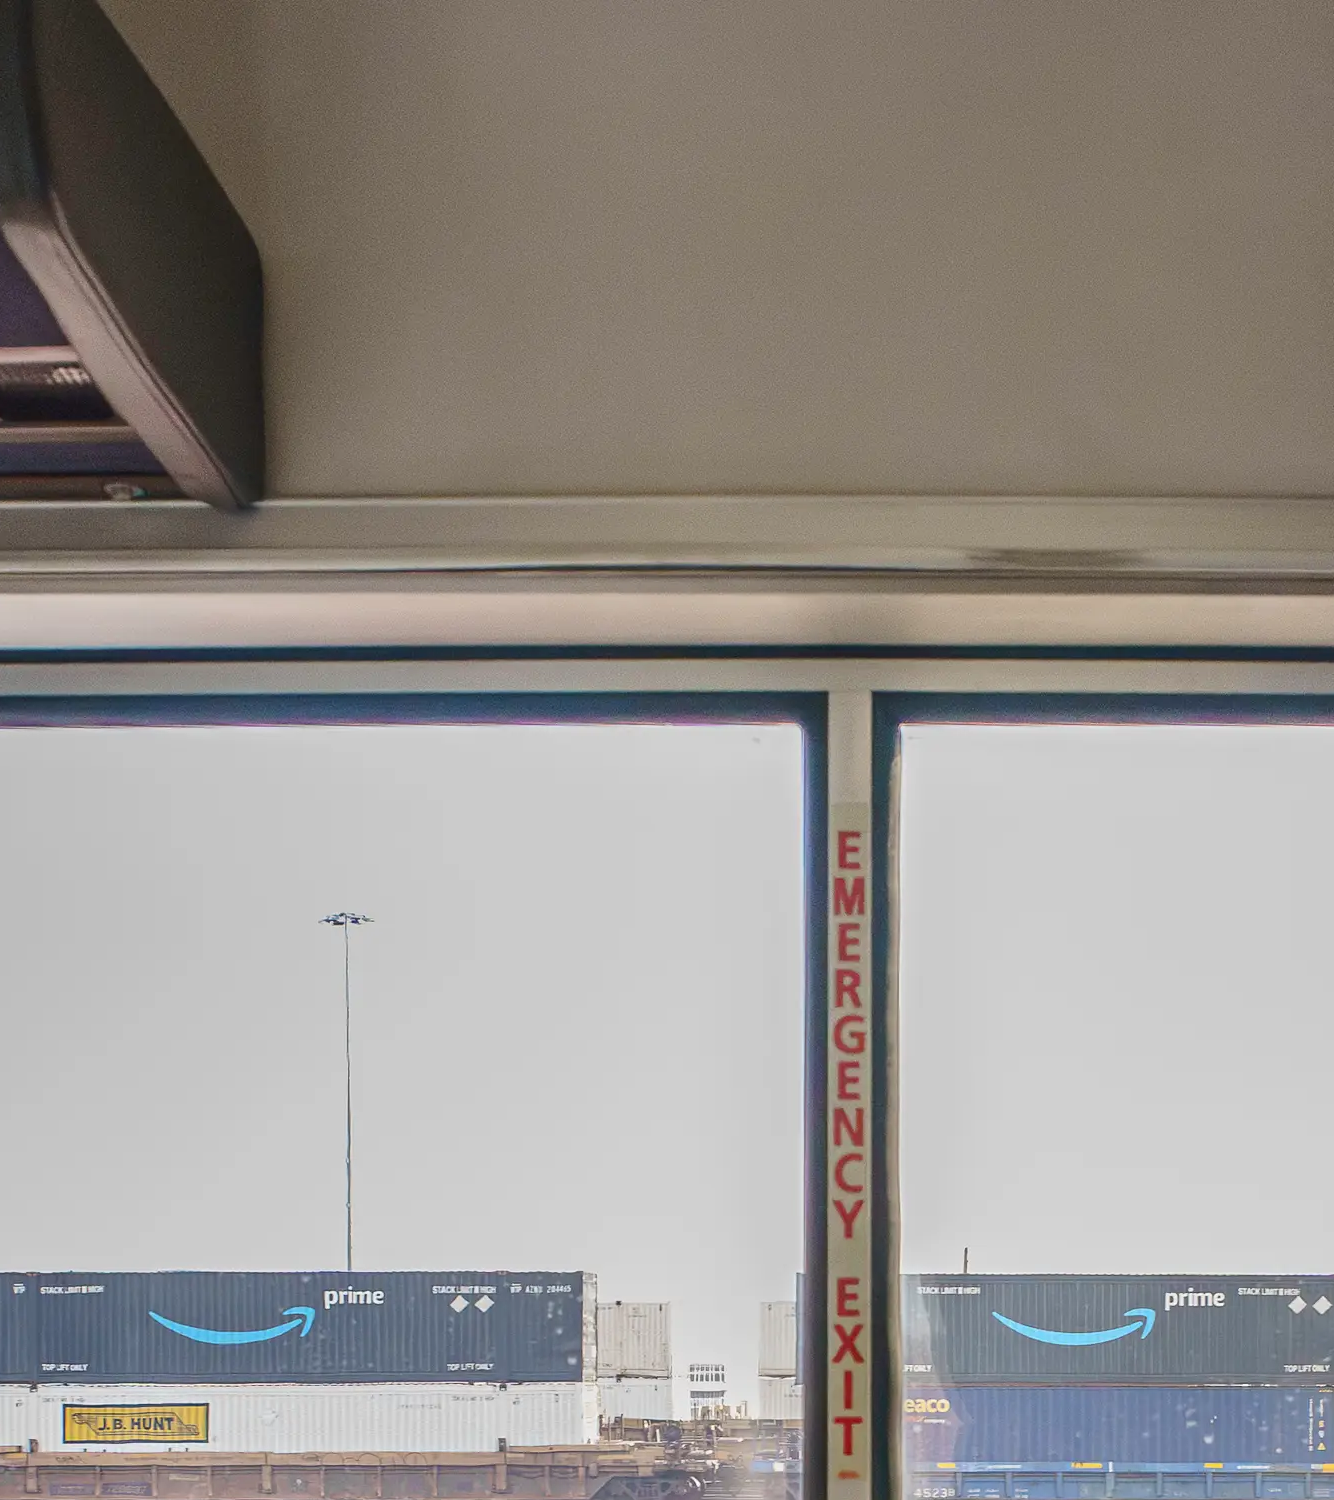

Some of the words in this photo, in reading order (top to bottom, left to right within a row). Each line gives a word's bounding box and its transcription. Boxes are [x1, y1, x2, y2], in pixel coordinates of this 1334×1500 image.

[833, 830, 866, 1240] EMERGENCY
[432, 1285, 456, 1294] STACK
[1237, 1287, 1261, 1296] STACK
[324, 1285, 385, 1310] prime
[1164, 1287, 1226, 1311] prime
[447, 1363, 460, 1372] TOP
[832, 1276, 865, 1456] EXIT
[1283, 1364, 1298, 1373] TOP
[98, 1417, 110, 1431] J.
[113, 1417, 126, 1431] B.
[130, 1417, 174, 1431] HUNT
